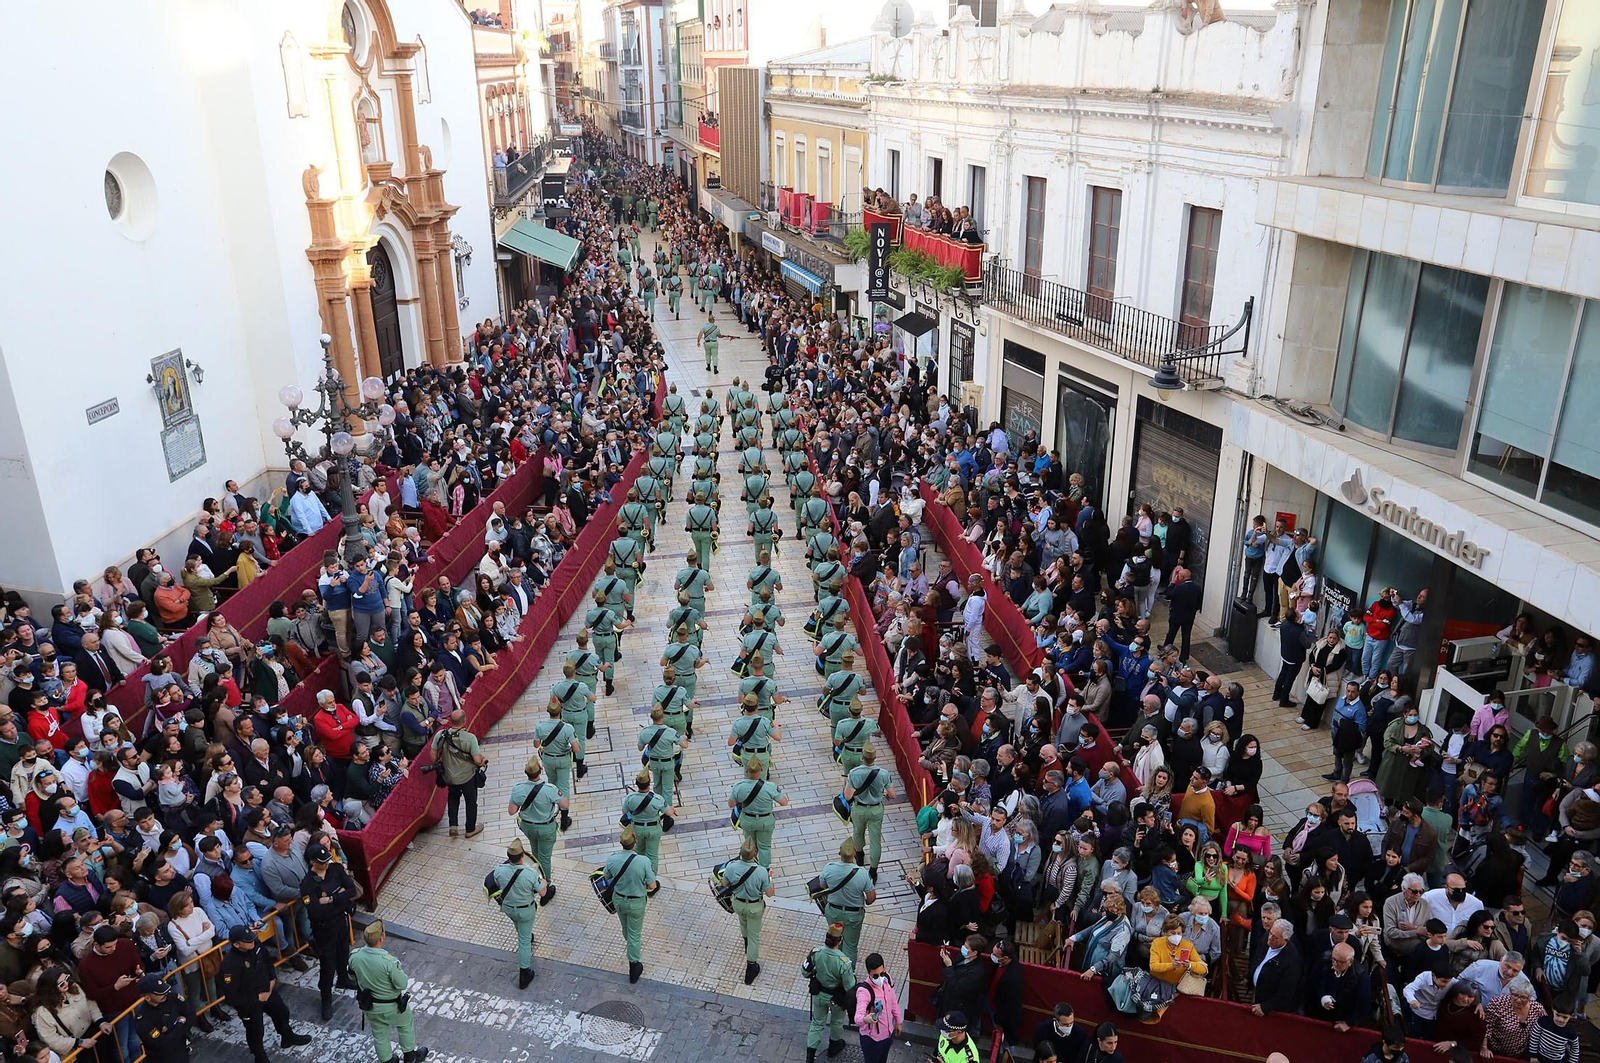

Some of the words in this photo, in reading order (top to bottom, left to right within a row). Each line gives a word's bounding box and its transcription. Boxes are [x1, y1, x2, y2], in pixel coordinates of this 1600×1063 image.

[875, 227, 885, 288] NOVI@S
[1367, 487, 1490, 569] Santander
[1547, 949, 1568, 959] NASA
